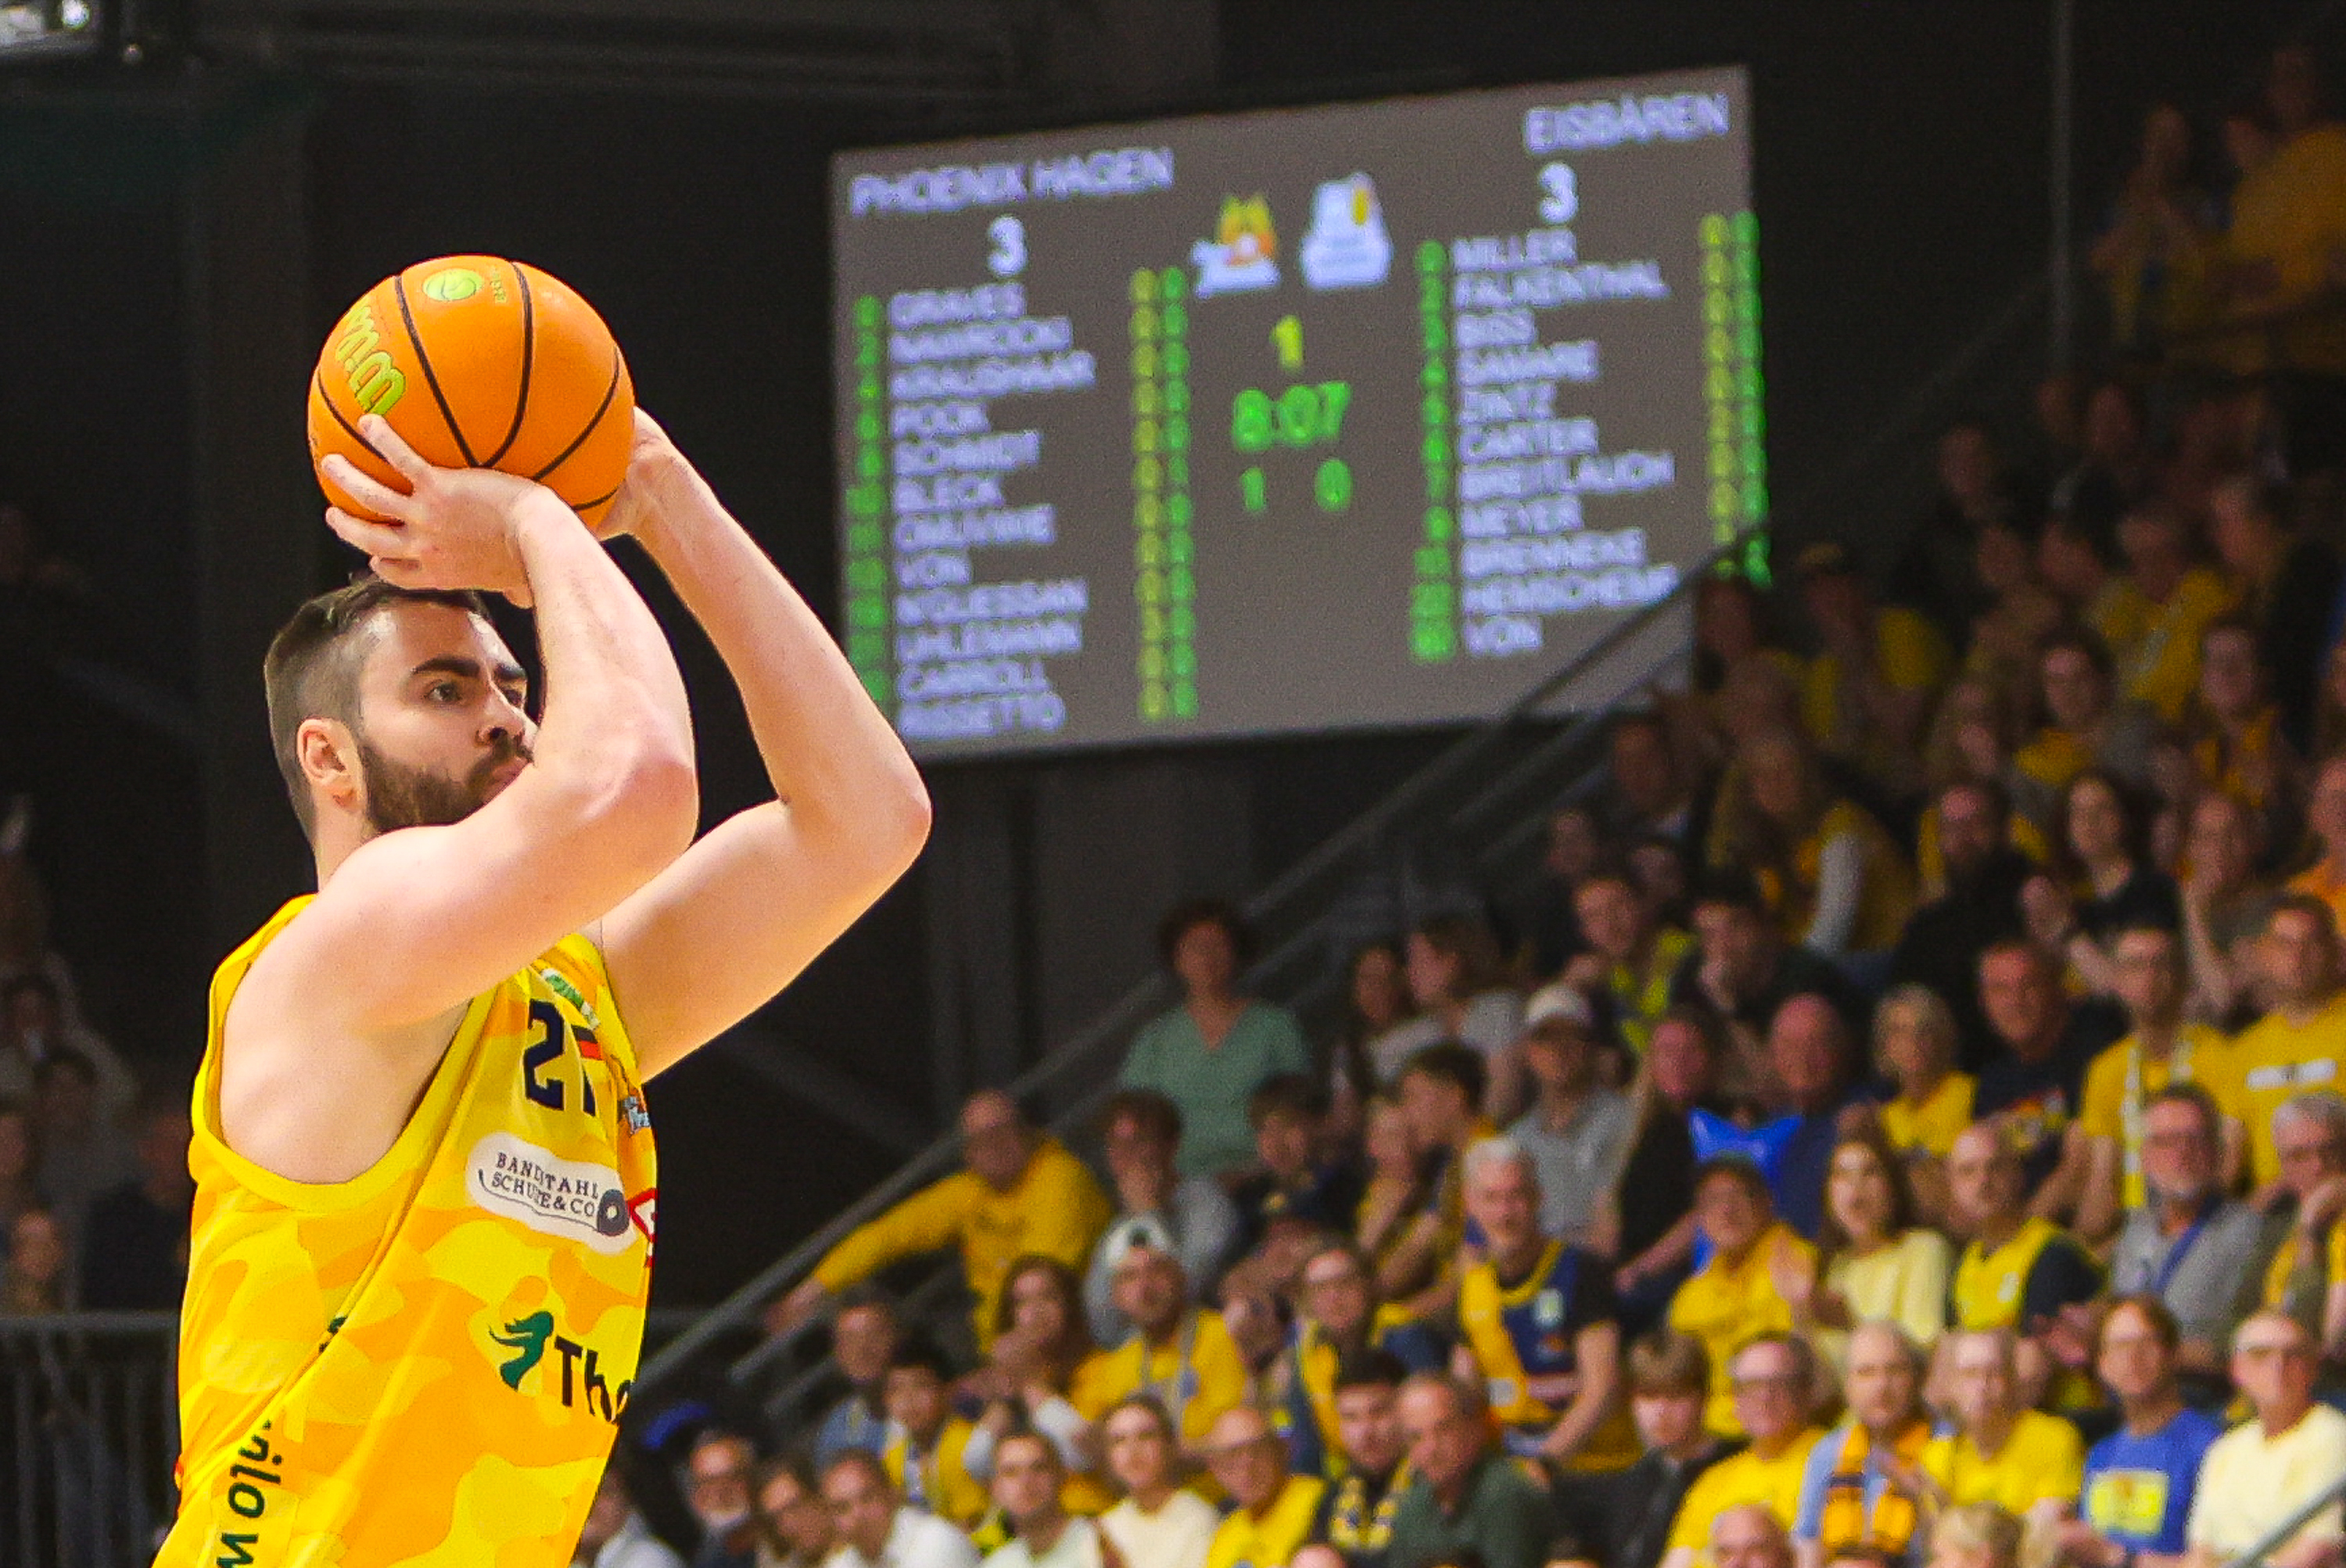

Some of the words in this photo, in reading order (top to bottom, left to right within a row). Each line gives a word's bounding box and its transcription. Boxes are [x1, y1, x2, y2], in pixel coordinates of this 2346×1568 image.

[1525, 93, 1729, 153] EISBÄREN
[851, 163, 1027, 217] PHOENIX
[1033, 148, 1173, 199] HAGEN
[1538, 163, 1577, 223] 3
[988, 216, 1027, 275] 3
[1455, 231, 1576, 271] MILLER
[1232, 380, 1353, 452] 8:07
